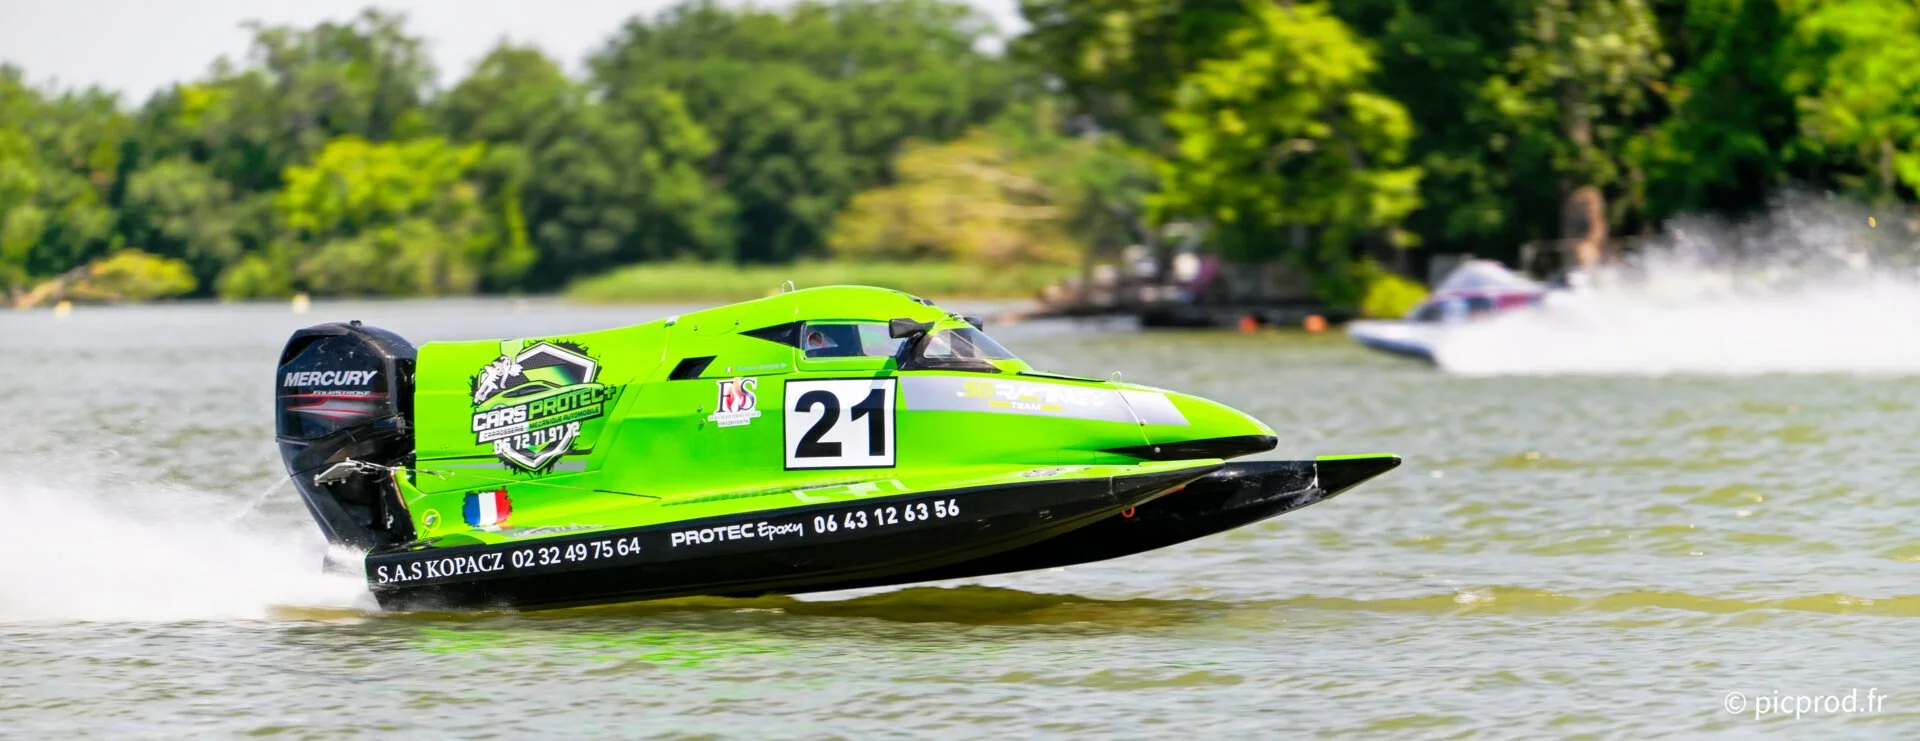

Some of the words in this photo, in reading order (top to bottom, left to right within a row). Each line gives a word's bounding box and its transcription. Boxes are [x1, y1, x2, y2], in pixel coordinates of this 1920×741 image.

[284, 370, 378, 387] MERCURY
[995, 383, 1090, 405] RACING
[473, 405, 526, 430] CARS
[563, 407, 600, 421] AUTOMOBILE
[1011, 402, 1040, 411] TEAM
[483, 427, 525, 439] CARROSSERIE
[795, 388, 886, 458] 21
[494, 438, 511, 454] 06
[514, 433, 529, 450] 72
[531, 428, 545, 446] 71
[548, 424, 564, 442] 97
[671, 524, 755, 547] PROTEC
[758, 521, 803, 541] Epoxy
[814, 515, 838, 533] 06
[844, 511, 868, 530] 43
[875, 507, 898, 526] 12
[904, 503, 929, 522] 63
[934, 499, 960, 518] 56
[377, 562, 422, 584] S.A.S
[426, 553, 504, 578] KOPACZ
[512, 550, 535, 568] 02
[538, 547, 561, 565] 32
[565, 544, 587, 562] 49
[591, 540, 613, 559] 75
[617, 537, 641, 556] 64
